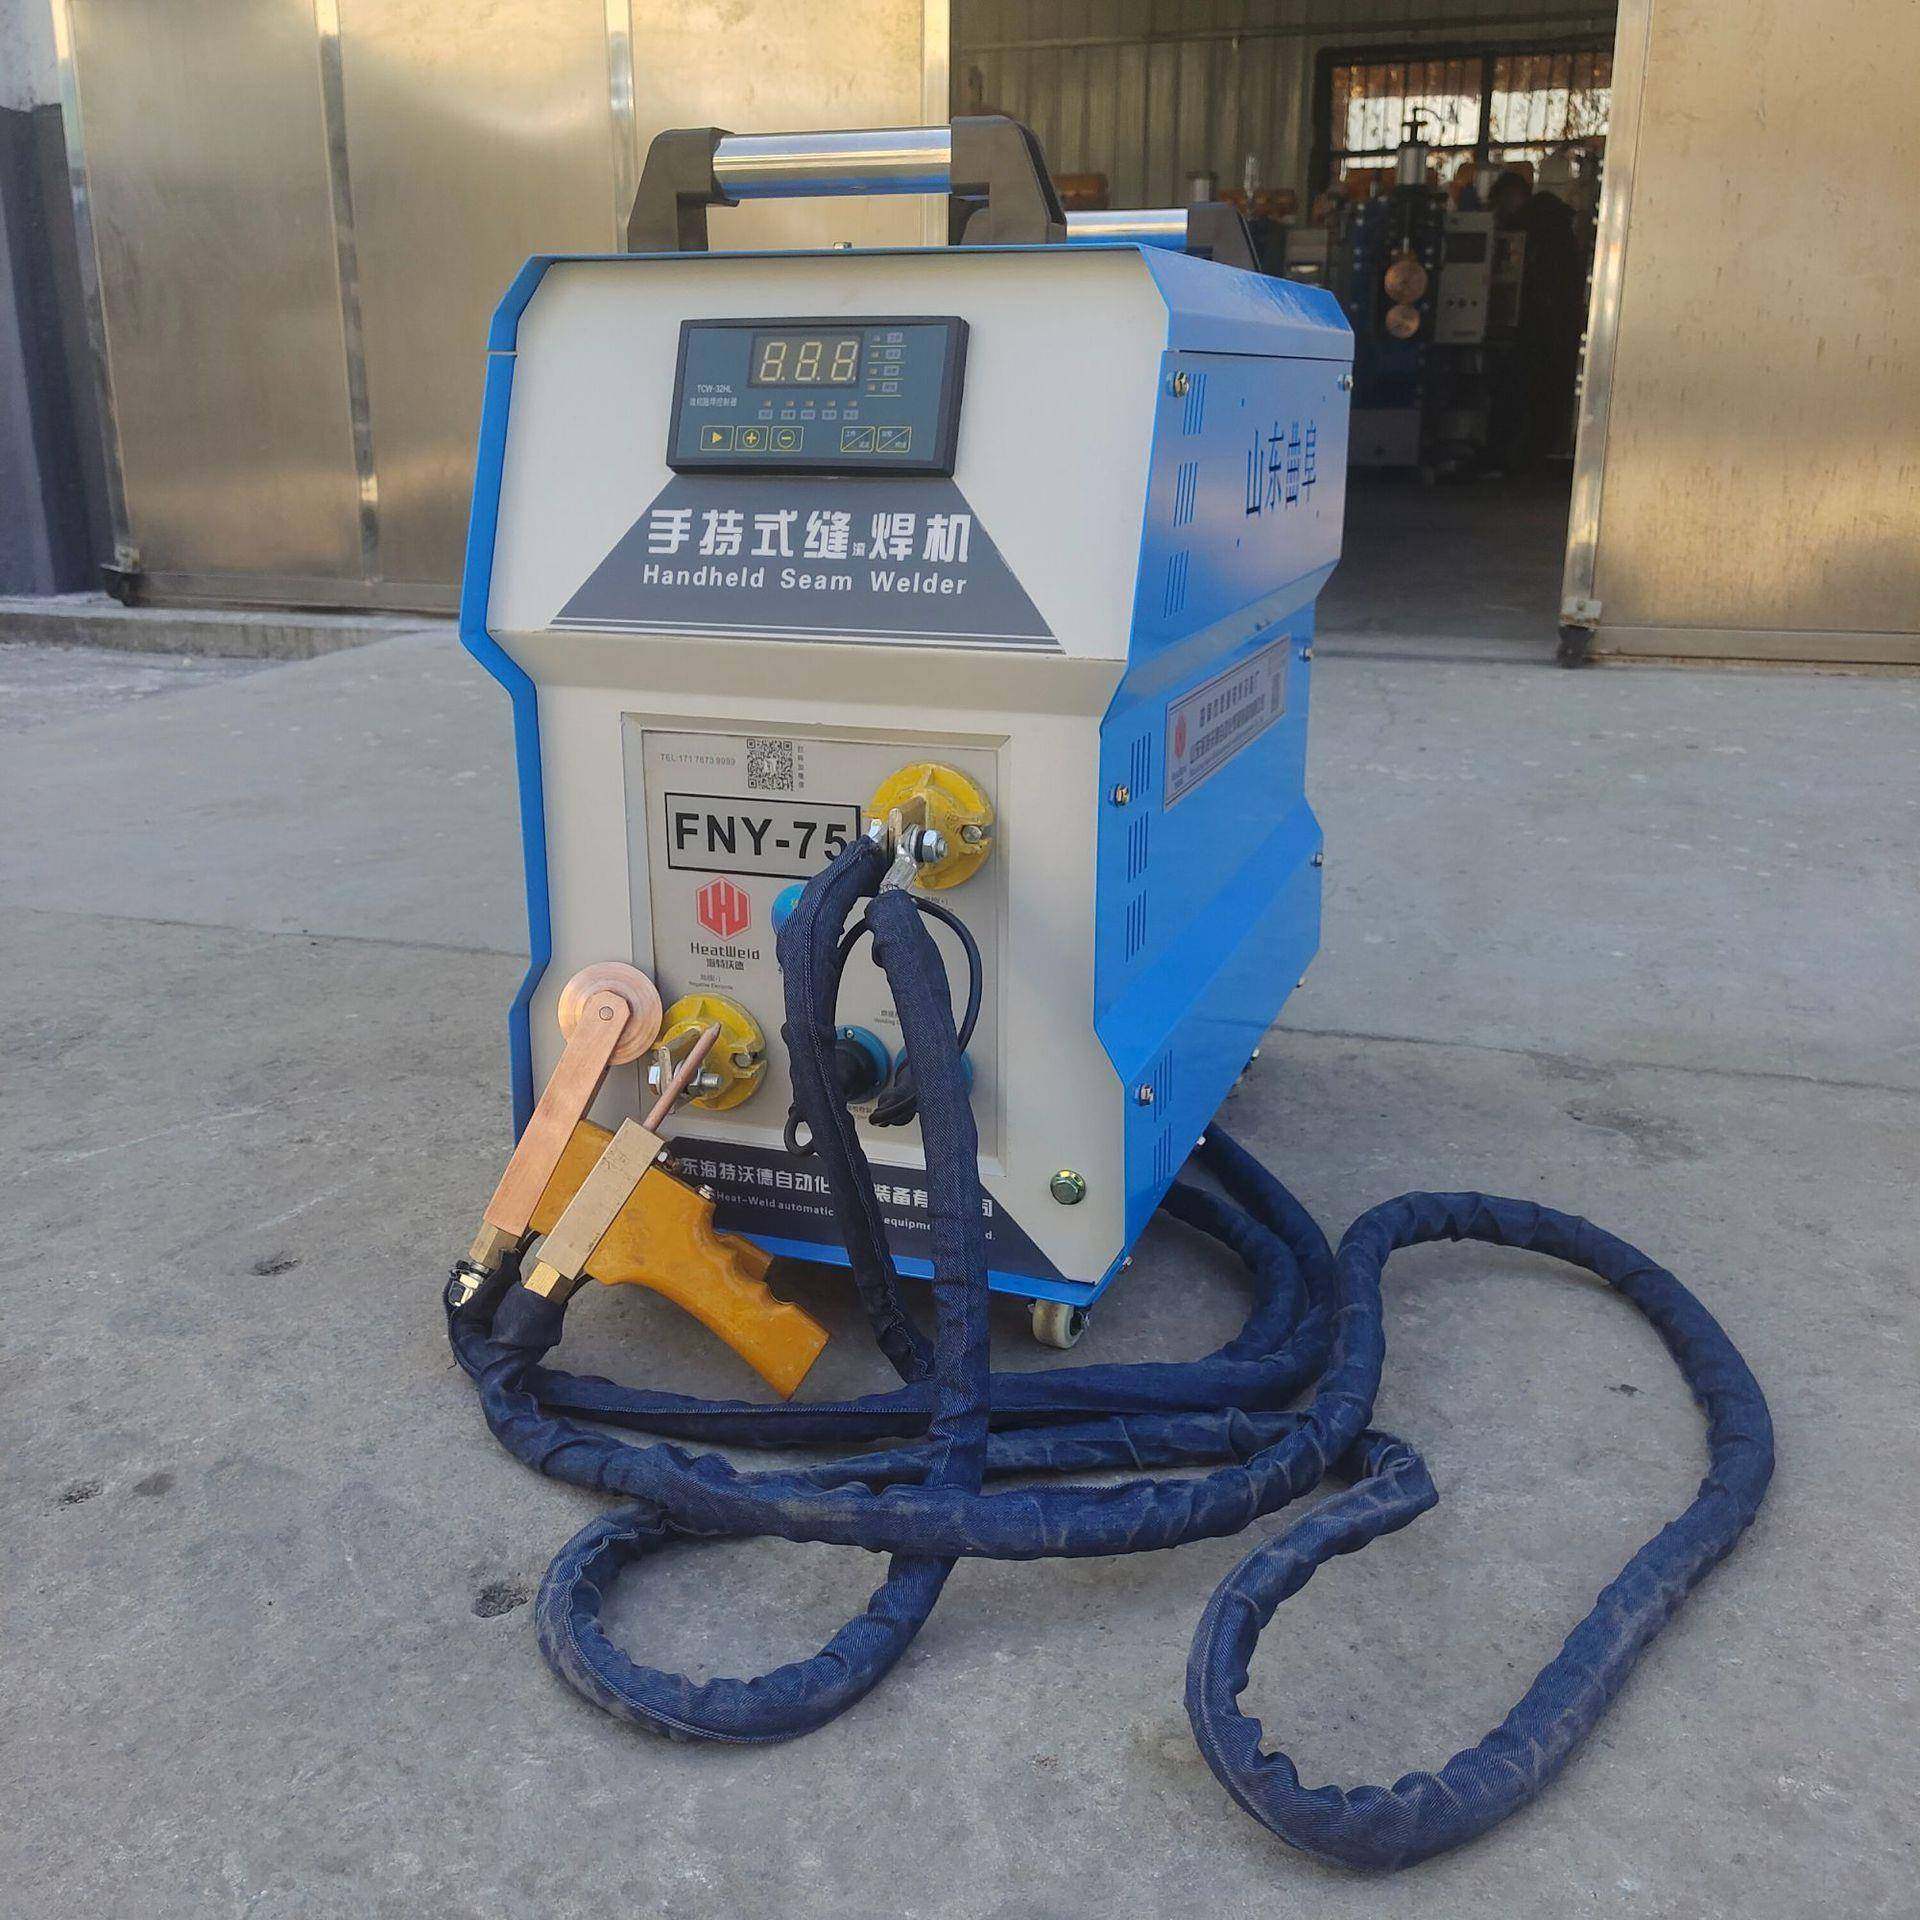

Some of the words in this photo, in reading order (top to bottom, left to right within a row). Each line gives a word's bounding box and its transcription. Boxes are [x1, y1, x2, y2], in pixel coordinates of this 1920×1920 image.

[643, 564, 764, 589] Handheld
[780, 568, 853, 592] Seam
[871, 571, 968, 595] Welder
[674, 812, 848, 861] FNY-75
[690, 942, 760, 960] HeatWeld
[778, 1202, 835, 1217] automatic
[884, 1216, 930, 1231] equipm
